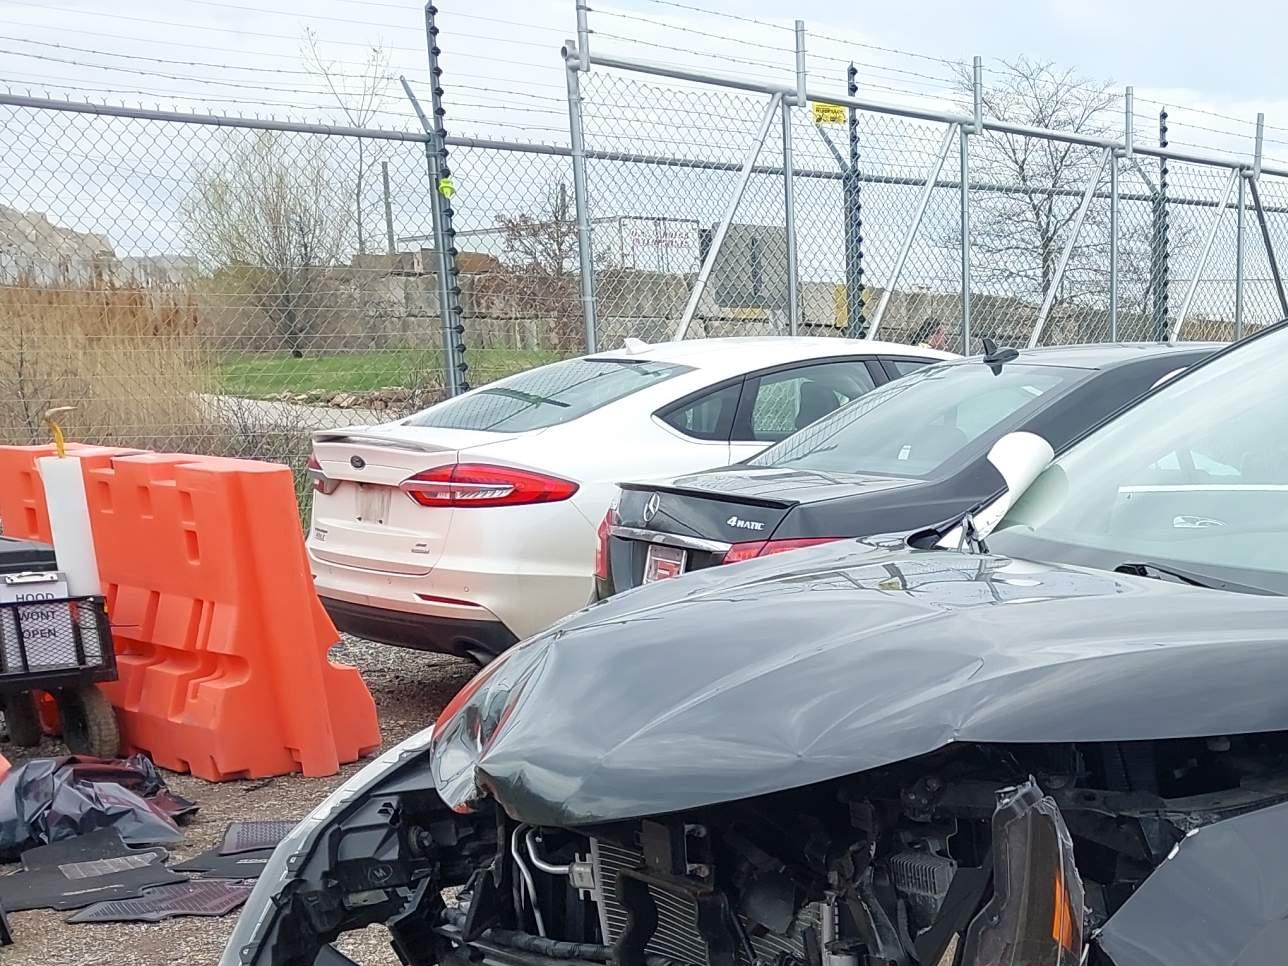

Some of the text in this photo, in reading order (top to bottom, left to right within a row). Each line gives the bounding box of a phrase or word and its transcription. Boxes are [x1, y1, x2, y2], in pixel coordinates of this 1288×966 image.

[727, 516, 765, 530] 4MATIC
[16, 592, 55, 602] HOOD
[20, 610, 57, 620] WONT
[23, 628, 57, 639] OPEN
